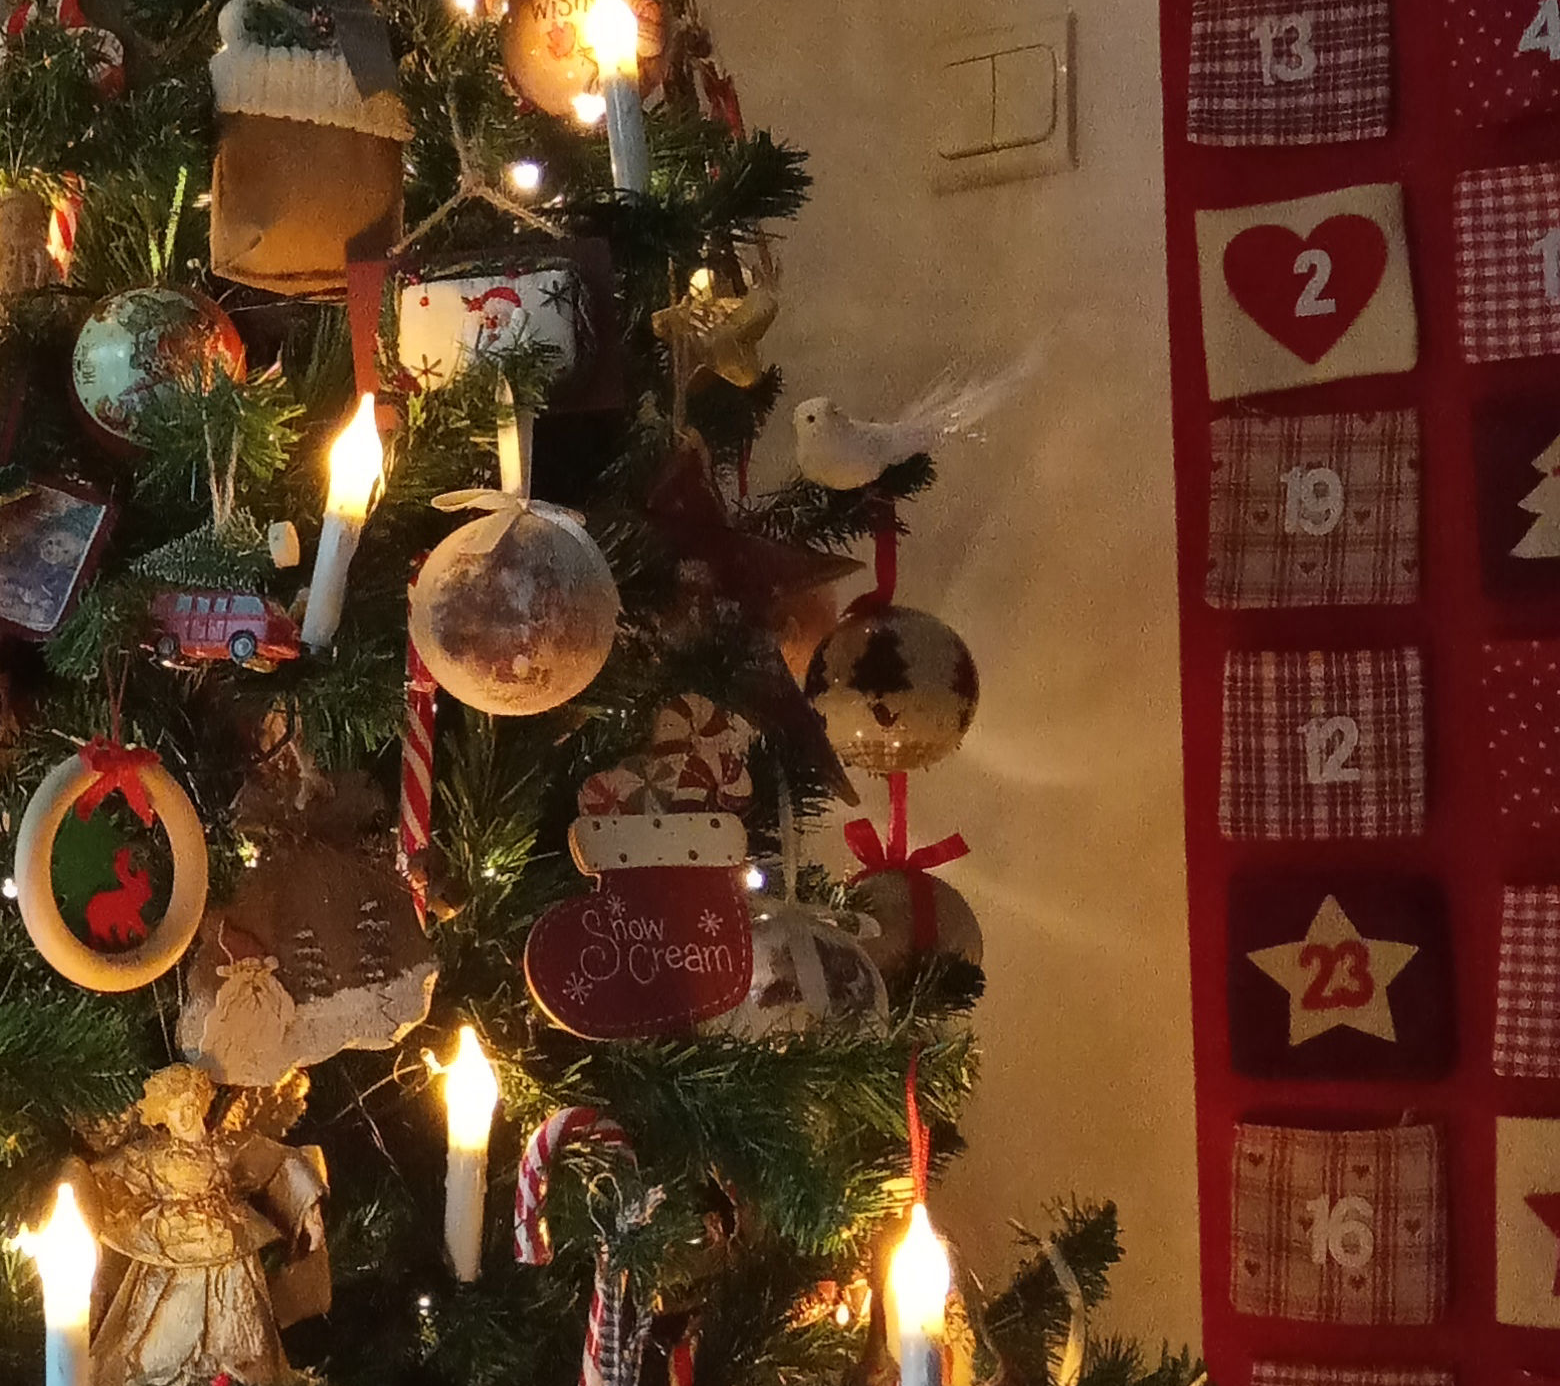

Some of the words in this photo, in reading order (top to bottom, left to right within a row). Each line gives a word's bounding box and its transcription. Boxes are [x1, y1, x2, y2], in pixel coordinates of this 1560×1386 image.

[1250, 13, 1319, 86] 13
[1293, 249, 1337, 318] 2
[1280, 466, 1345, 536] 19
[1297, 715, 1361, 784] 12
[580, 909, 665, 981] Snow
[628, 943, 733, 985] Cream
[1297, 942, 1376, 1012] 23
[1306, 1193, 1375, 1269] 16
